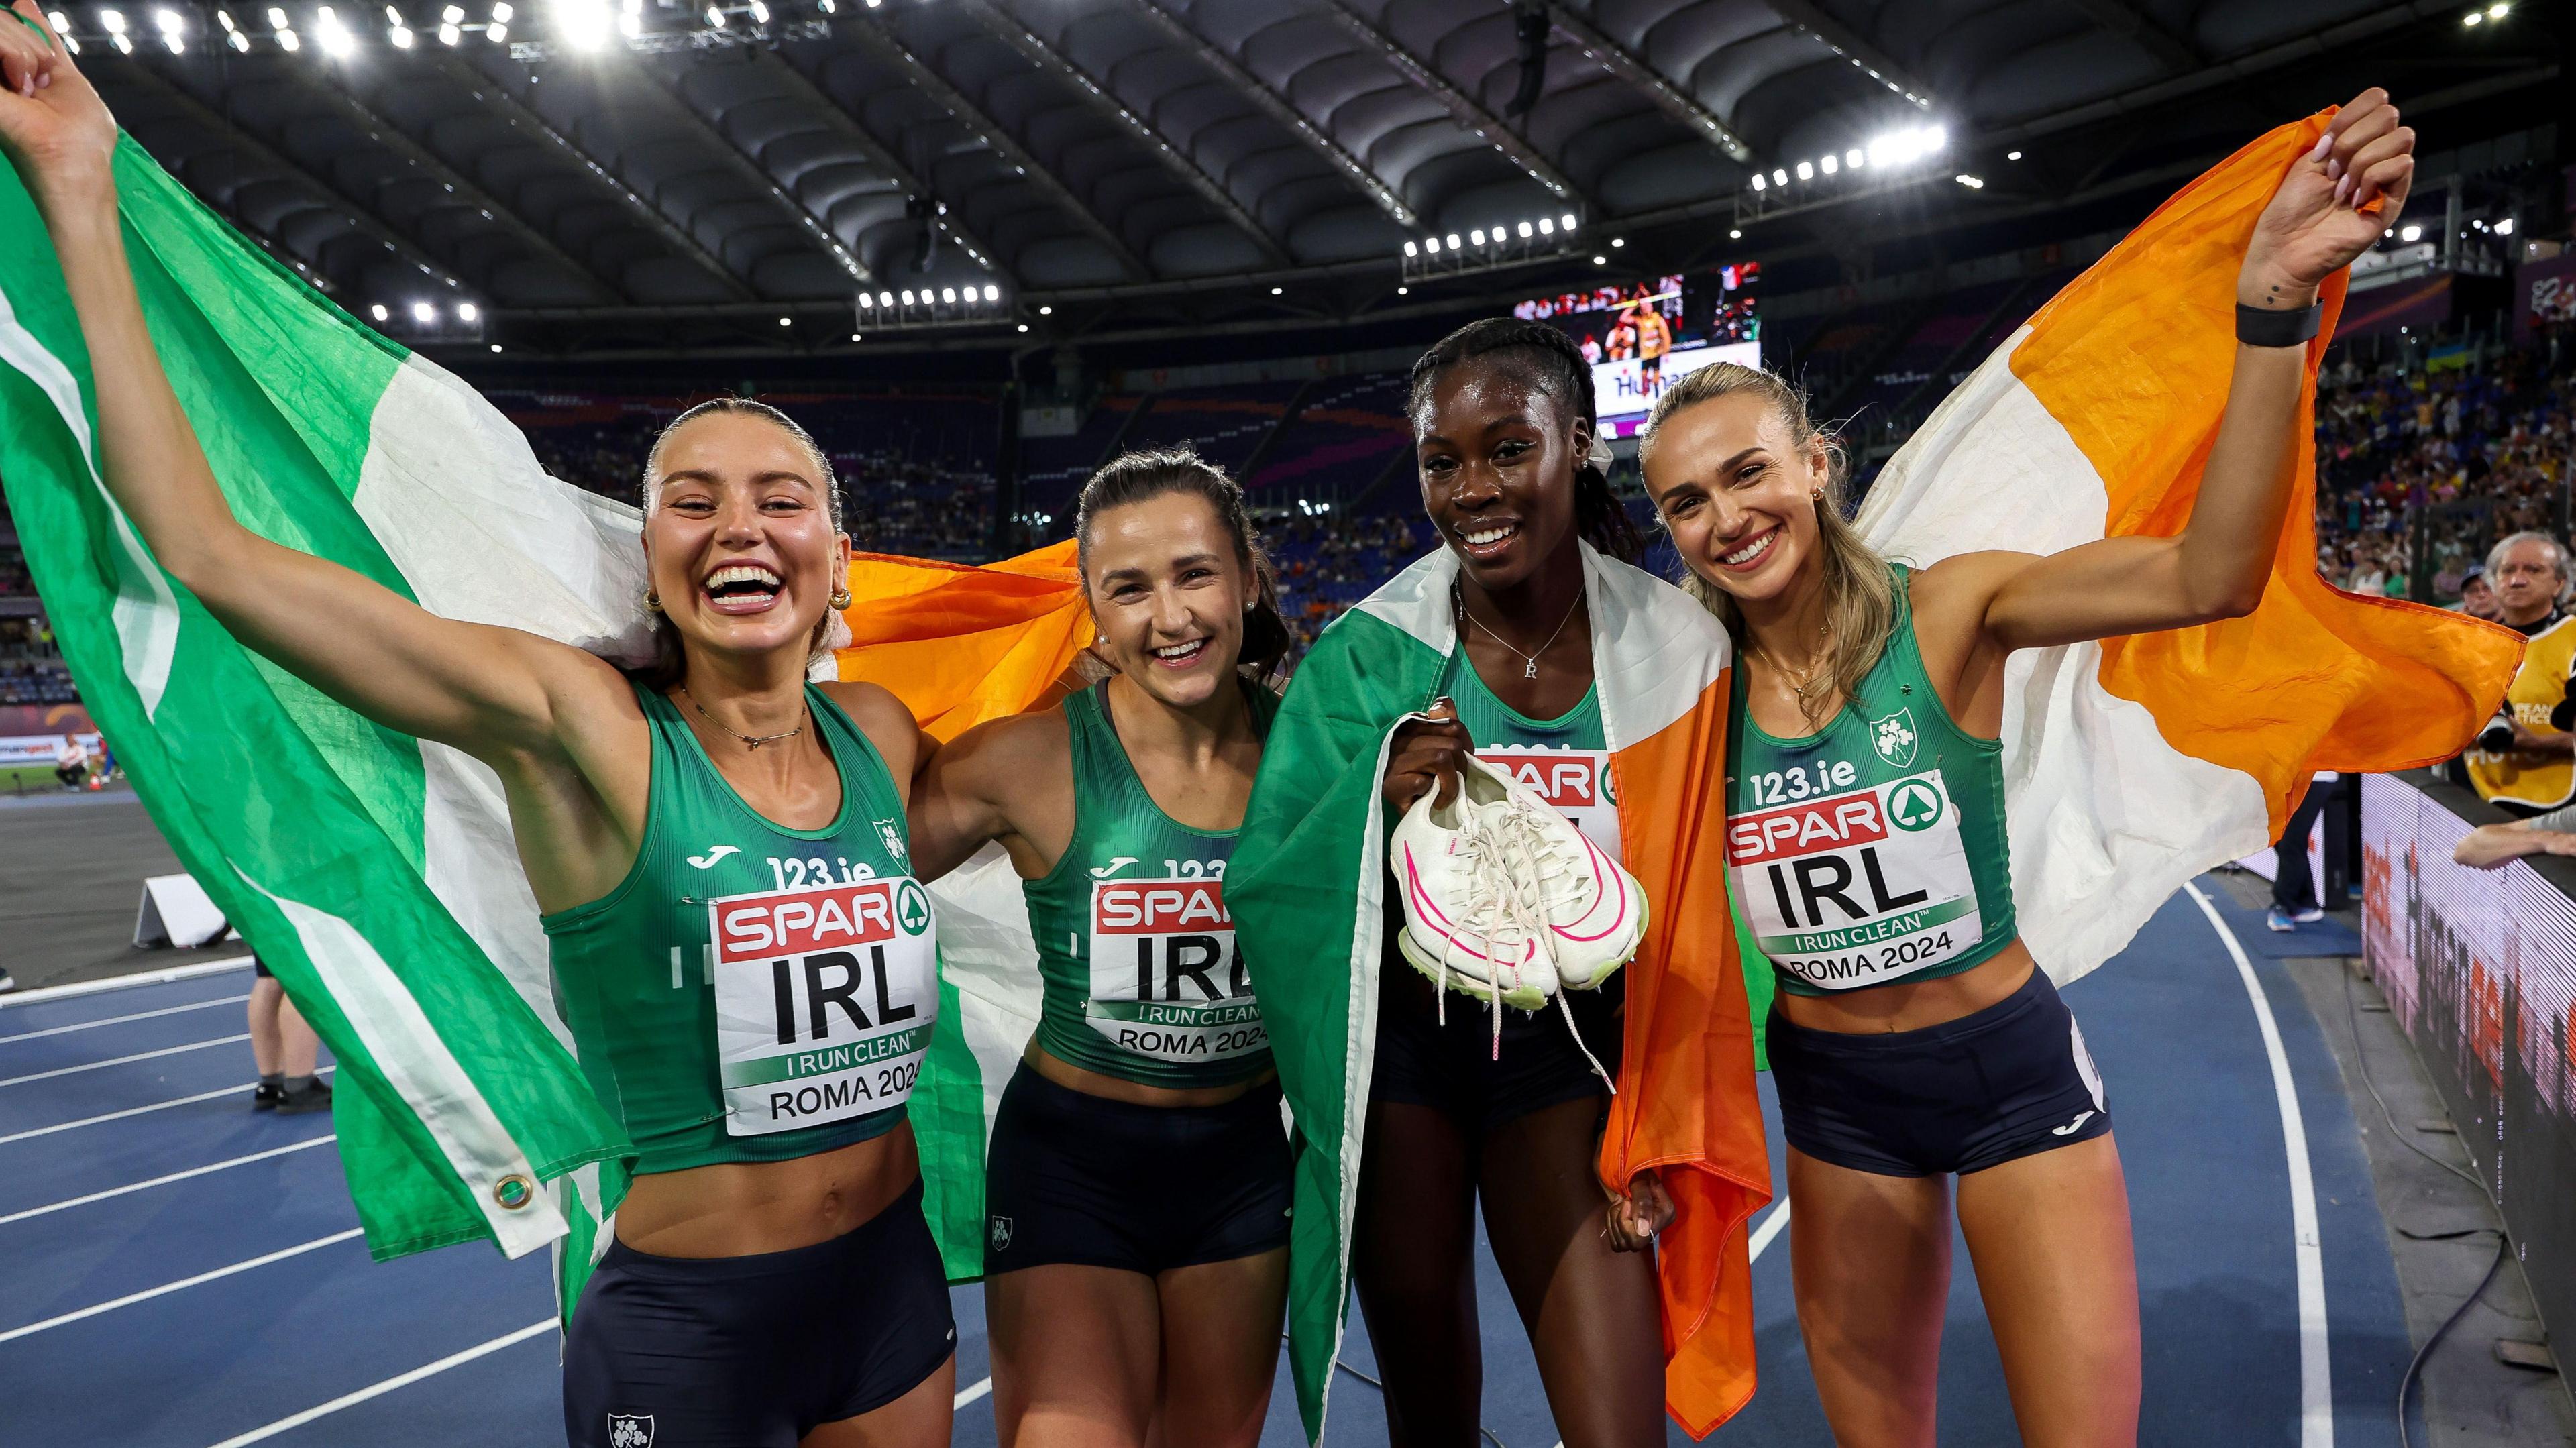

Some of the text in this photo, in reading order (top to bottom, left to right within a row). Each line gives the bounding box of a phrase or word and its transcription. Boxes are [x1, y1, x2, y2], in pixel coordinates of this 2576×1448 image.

[1484, 763, 1590, 799] AR
[1750, 759, 1856, 806] 123.ie
[1729, 800, 1881, 859] SPAR
[1102, 889, 1231, 927] SPA
[1767, 847, 1929, 929] IRL
[724, 892, 891, 952] SPAR
[1795, 936, 1801, 950] I
[1805, 932, 1846, 949] RUN
[1789, 931, 1954, 981] ROMA 2024
[771, 944, 916, 1045] IRL
[1139, 1005, 1260, 1025] I RUN CLEAN
[787, 1058, 793, 1076] I
[799, 1048, 851, 1074] RUN
[1119, 1028, 1209, 1055] ROMA
[771, 1075, 873, 1120] ROMA
